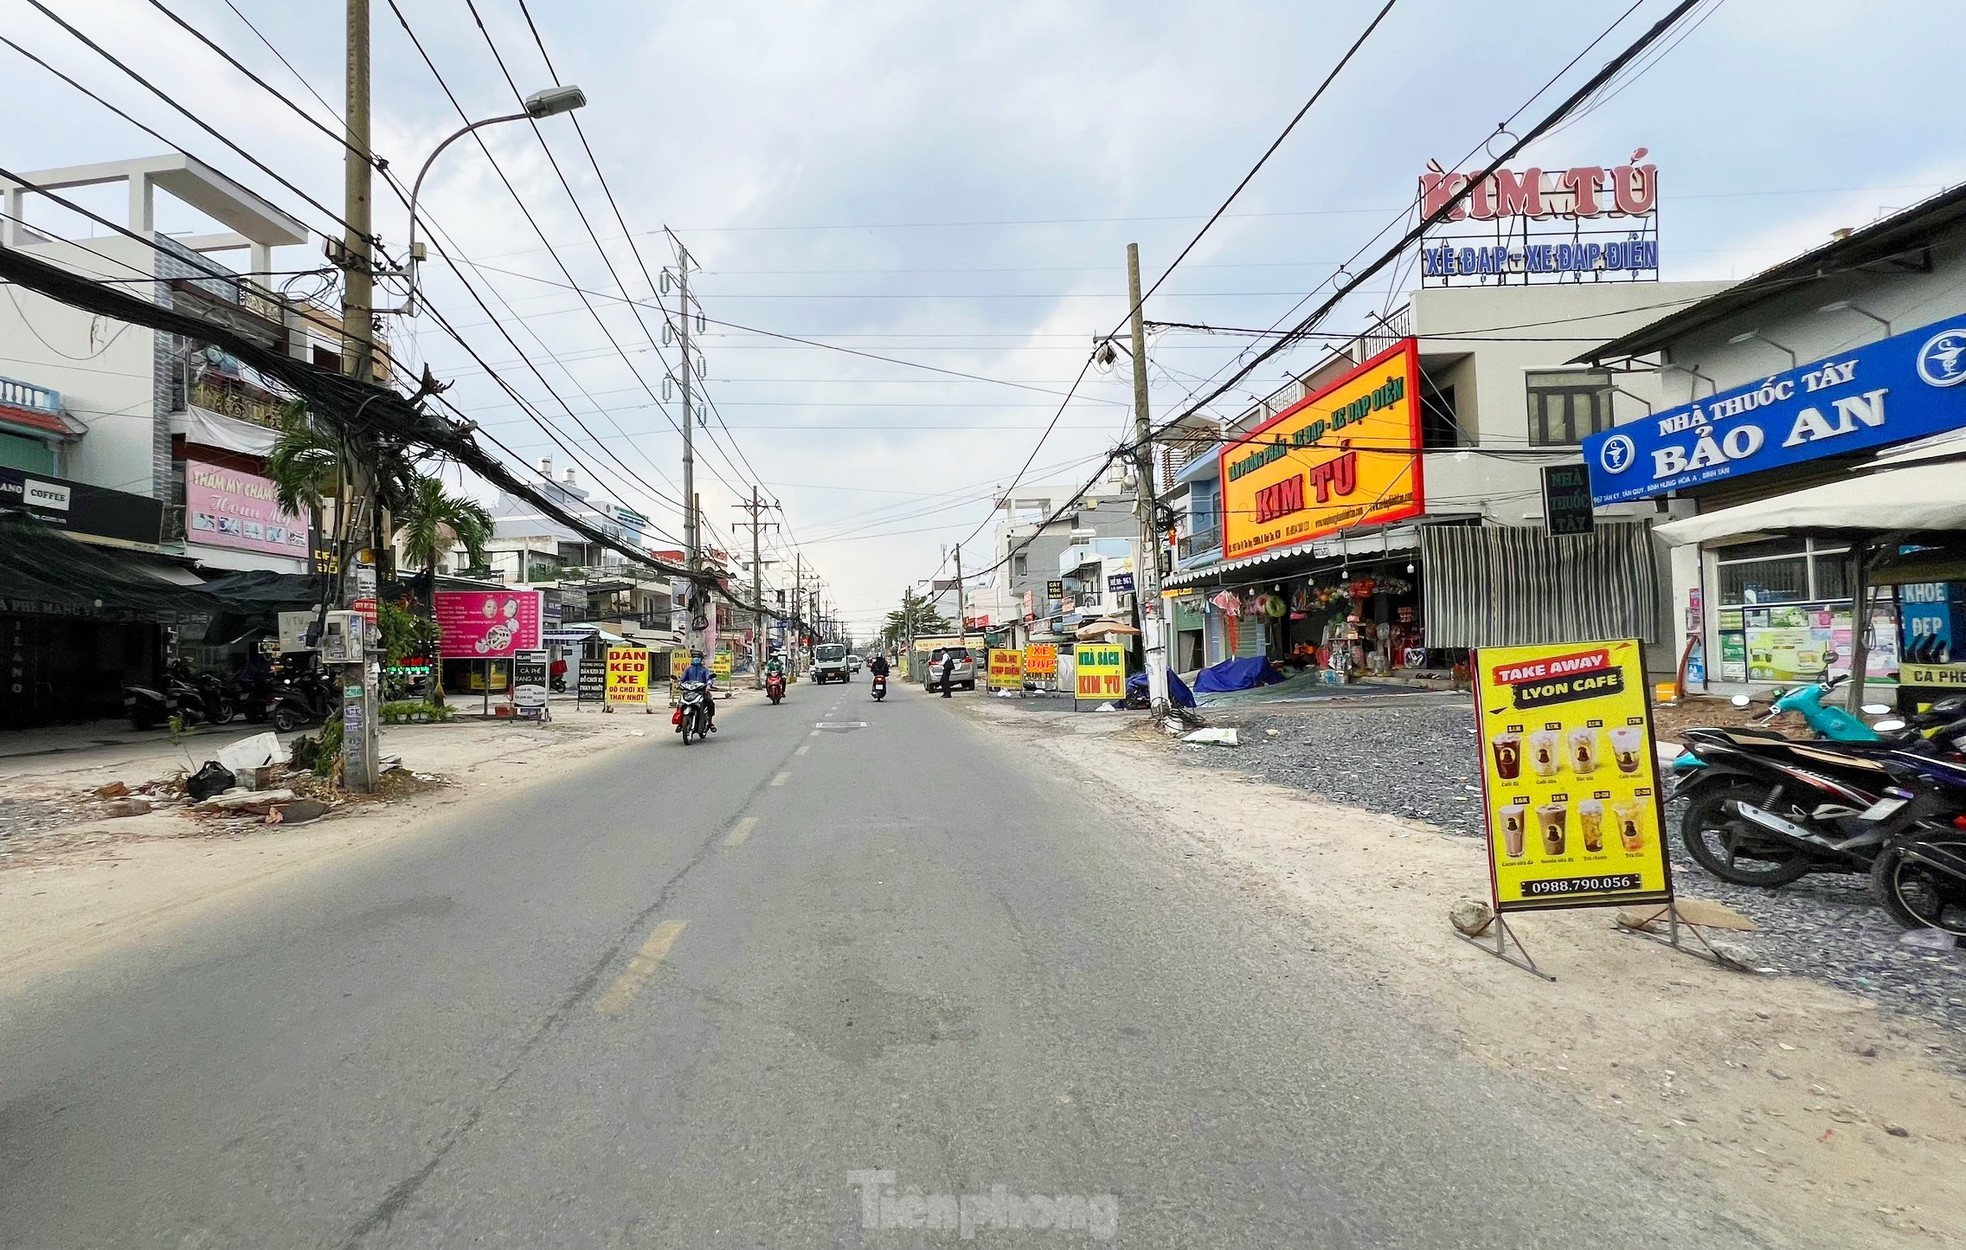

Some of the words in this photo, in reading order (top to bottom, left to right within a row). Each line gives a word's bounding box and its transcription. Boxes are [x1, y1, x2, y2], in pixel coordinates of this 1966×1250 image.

[1420, 167, 1544, 221] KIM
[1564, 147, 1657, 219] TÚ
[1424, 247, 1455, 275] XE
[1525, 244, 1553, 271] XE
[1658, 405, 1709, 437] NHÀ
[1709, 376, 1795, 421] THUỐC
[1801, 360, 1860, 393] TÂY
[1331, 407, 1347, 431] XE
[1651, 424, 1764, 479] BẢO
[1782, 388, 1889, 448] AN
[1255, 473, 1304, 524] KIM
[1310, 439, 1357, 504] TÚ
[30, 488, 66, 502] COFFEE
[609, 650, 646, 661] DÁN
[1033, 645, 1050, 656] XE
[1078, 649, 1095, 665] NHÀ
[1097, 648, 1120, 666] SÁCH
[610, 663, 645, 672] KEO
[616, 675, 639, 684] XE
[1499, 664, 1546, 682] TAKE
[1550, 654, 1603, 674] AWAY
[1078, 675, 1101, 694] KIM
[1104, 670, 1121, 694] TÚ
[1522, 682, 1569, 701] LYON
[1572, 674, 1618, 692] CAFE
[1532, 876, 1631, 894] 0988.790.056
